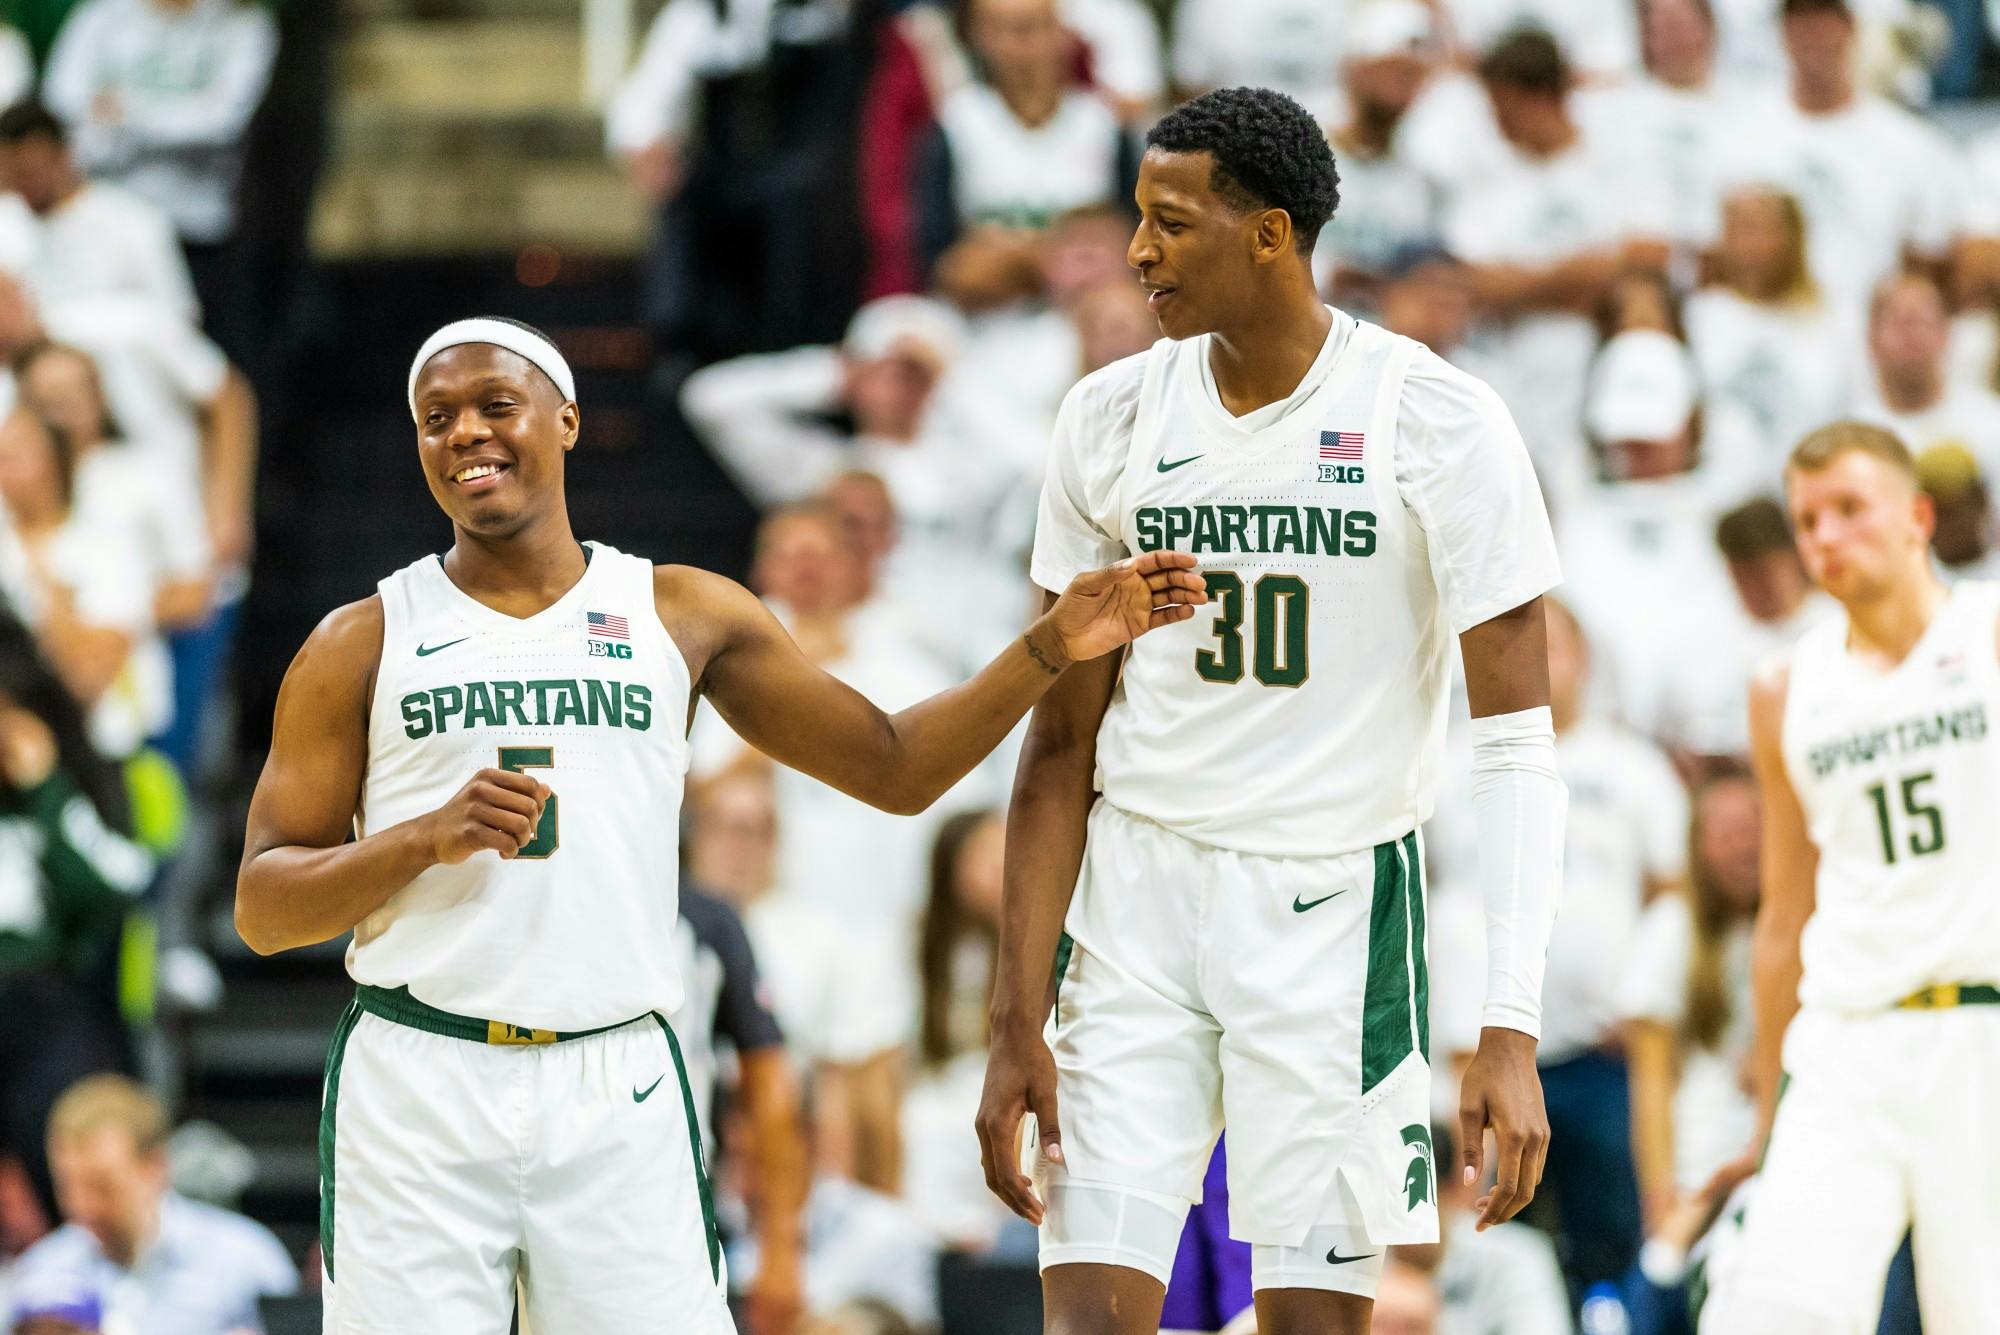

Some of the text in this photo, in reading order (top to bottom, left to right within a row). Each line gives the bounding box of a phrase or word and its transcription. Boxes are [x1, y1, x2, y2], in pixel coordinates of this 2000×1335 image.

[1136, 505, 1377, 558] SPARTANS
[1195, 571, 1310, 688] 30
[400, 678, 652, 740] SPARTANS
[1865, 771, 1946, 865] 15
